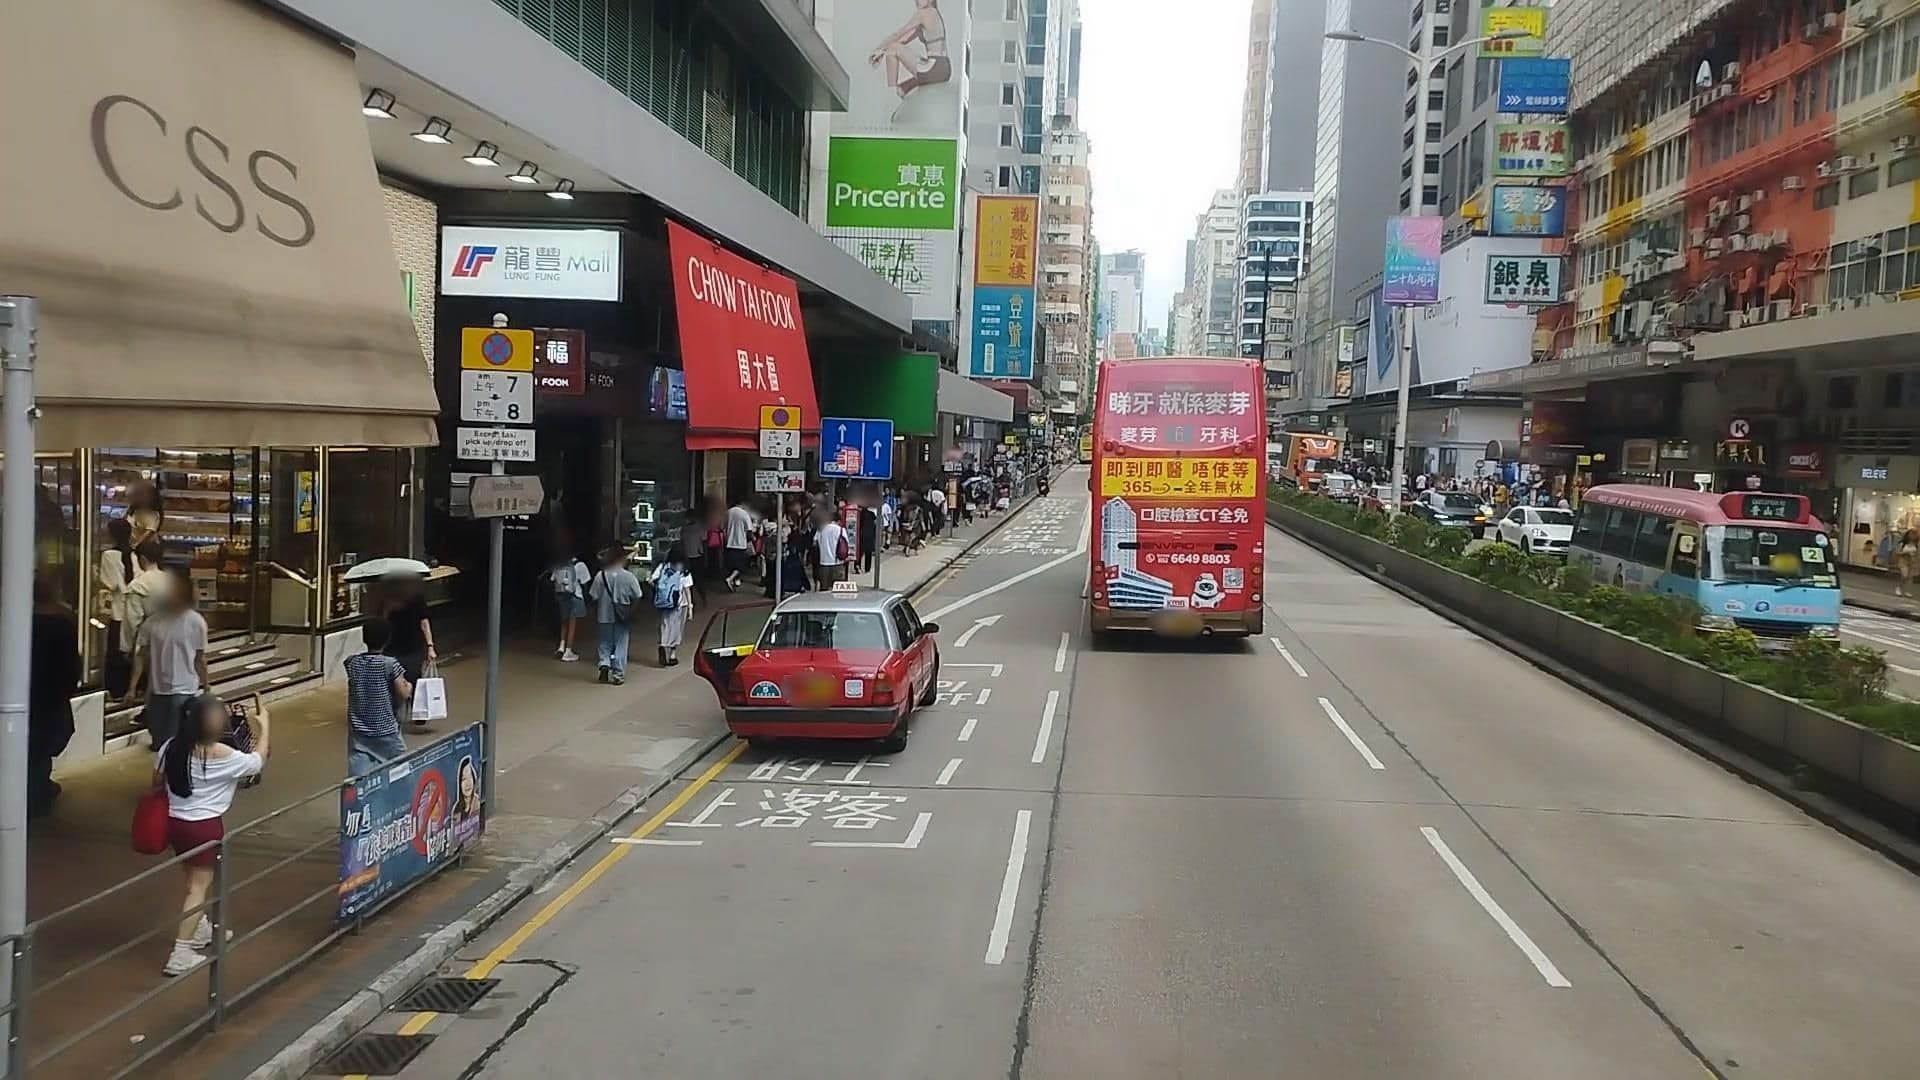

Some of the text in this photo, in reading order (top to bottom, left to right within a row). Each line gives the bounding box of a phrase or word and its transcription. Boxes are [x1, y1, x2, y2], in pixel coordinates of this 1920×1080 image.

[91, 95, 315, 247] CSS
[897, 163, 945, 186] 實惠
[835, 182, 945, 209] Pricerite
[566, 256, 610, 273] Mall
[504, 272, 560, 281] LUNG FUNG
[1494, 260, 1550, 287] 銀泉
[688, 256, 796, 330] CHOW TAI FOOK
[737, 349, 780, 392] 周大福
[473, 383, 494, 392] 上午
[507, 376, 518, 393] 7
[542, 377, 569, 387] FOOK
[477, 400, 490, 408] pm
[508, 404, 520, 420] 8
[1109, 392, 1250, 416] 睇牙 就係麥芽
[473, 409, 494, 418] 下午
[785, 432, 792, 442] 7
[1120, 427, 1240, 443] 麥芽 牙科
[1734, 423, 1745, 435] K
[786, 447, 793, 457] 8
[1107, 461, 1249, 479] 即到即醫 唔使等
[1122, 481, 1151, 493] 365
[1184, 480, 1243, 494] 全年無休
[1141, 507, 1248, 523] 口腔檢查CT全免
[1171, 554, 1199, 564] 6649
[1201, 554, 1231, 564] 8803
[1809, 549, 1818, 559] 2
[747, 756, 890, 784] 的士
[665, 788, 907, 829] 上落客
